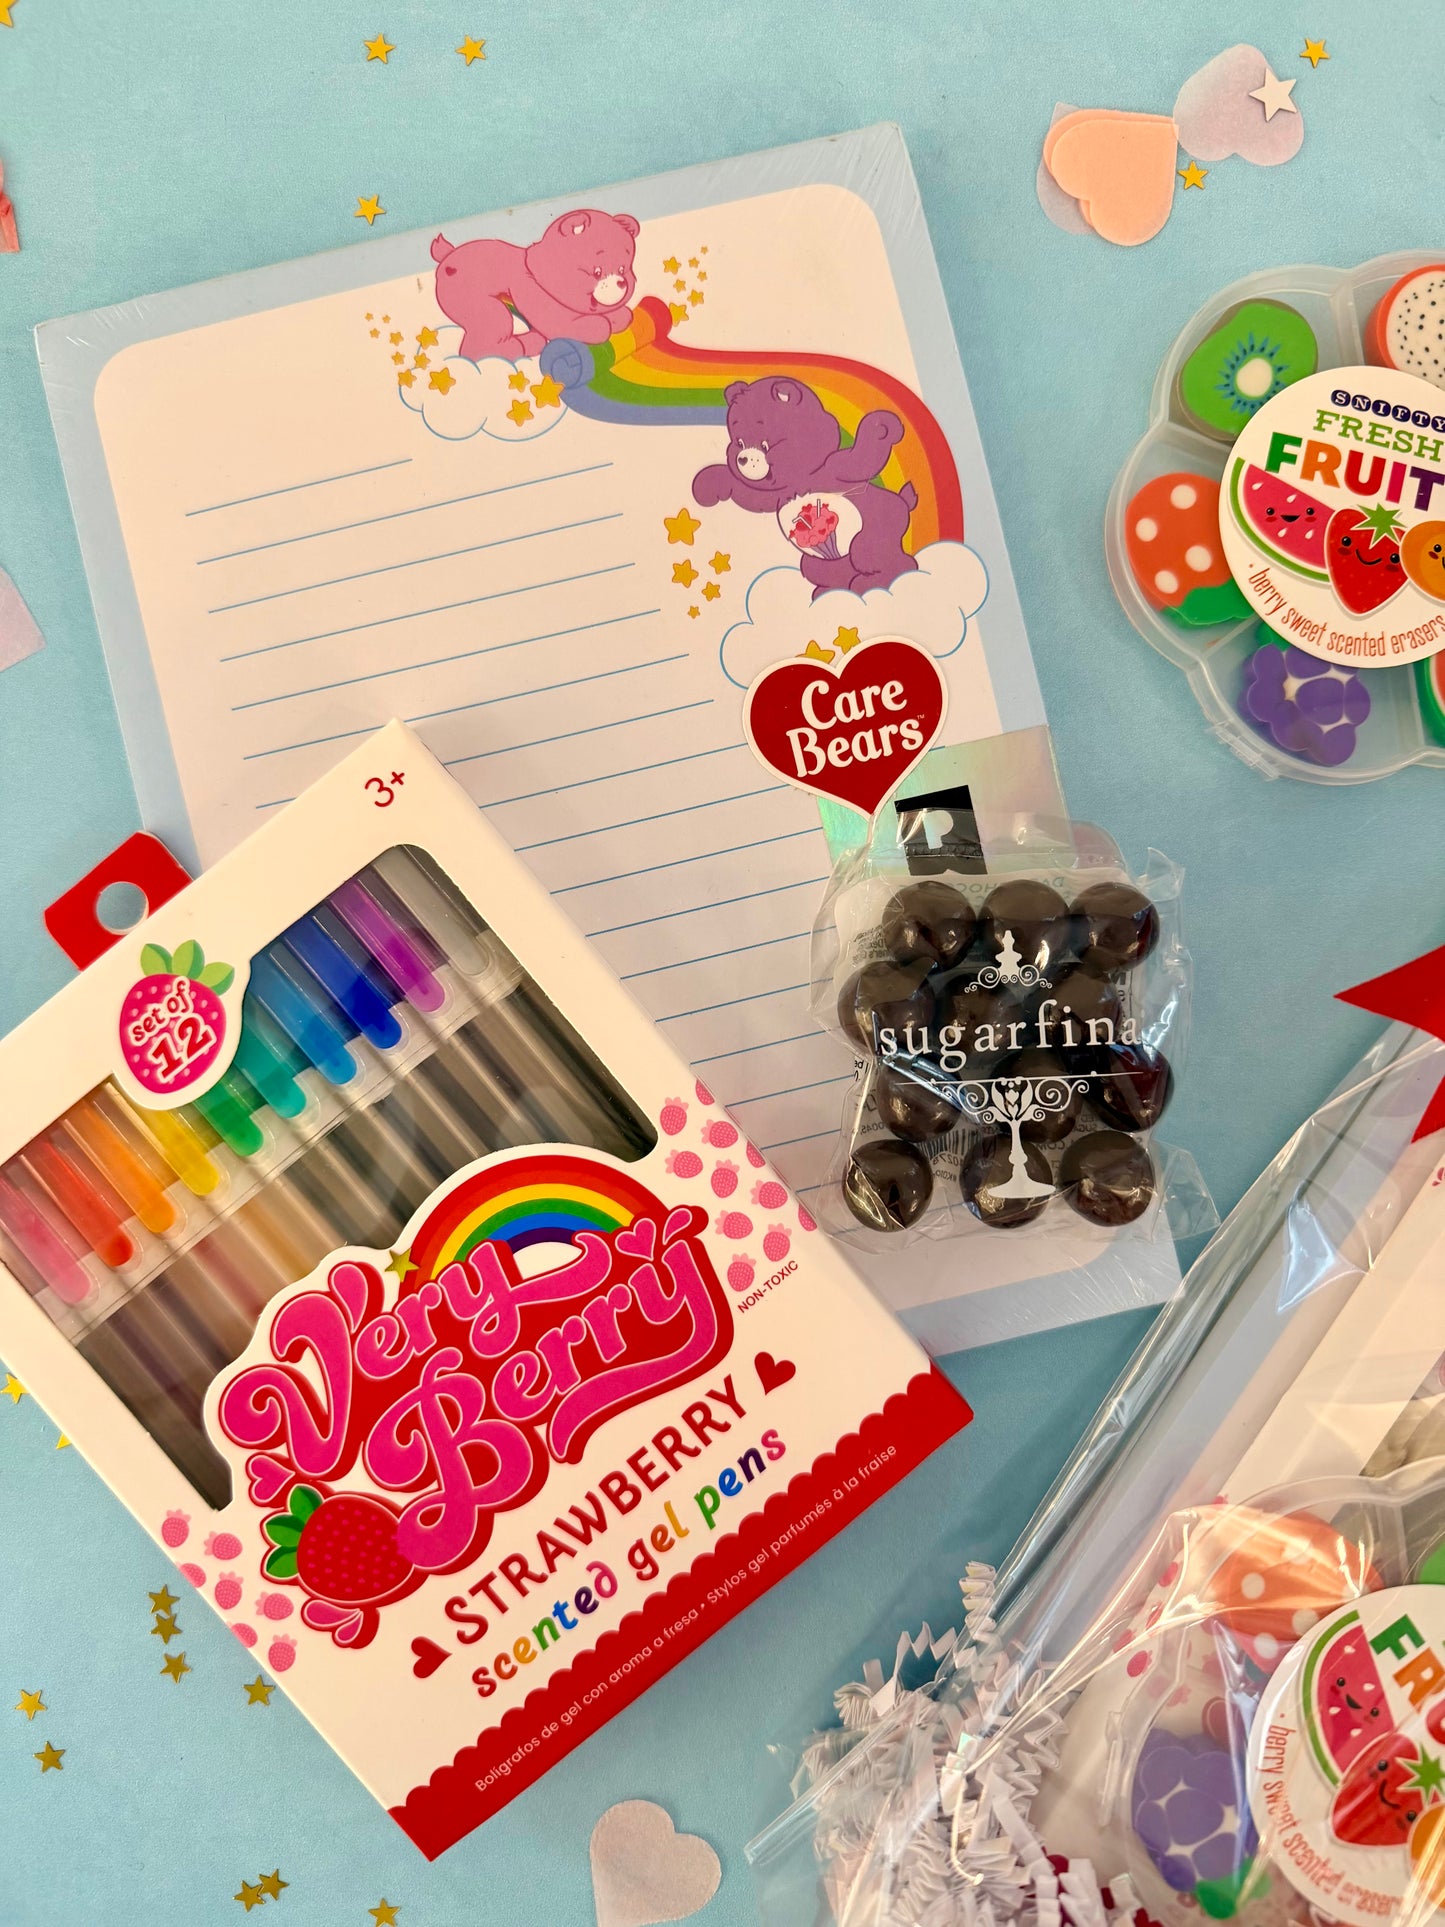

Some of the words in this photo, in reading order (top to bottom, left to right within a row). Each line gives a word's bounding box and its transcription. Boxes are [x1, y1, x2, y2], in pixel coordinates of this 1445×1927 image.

[1313, 409, 1444, 462] FRESH
[1331, 389, 1445, 434] SNIFTY
[1264, 431, 1445, 512] FRUIT
[1248, 567, 1287, 617] berry
[1281, 607, 1328, 647] sweet
[1326, 630, 1387, 658] scented
[1390, 614, 1445, 654] erasers
[800, 678, 908, 732] Care
[365, 771, 405, 807] 3+
[132, 1006, 166, 1042] set
[167, 980, 190, 1014] of
[878, 998, 1139, 1072] sugarfina
[151, 1016, 213, 1079] 12
[737, 1259, 799, 1314] NON-TOXIC
[220, 1232, 612, 1476] Very
[365, 1222, 718, 1569] Berry
[445, 1373, 747, 1645] STRAWBERRY
[471, 1560, 619, 1698] scented
[627, 1500, 690, 1582] gel
[693, 1429, 787, 1531] pens
[474, 1737, 541, 1792] Bolígrafos
[541, 1718, 560, 1739] de
[560, 1701, 583, 1726] gel
[582, 1681, 609, 1705] con
[608, 1646, 653, 1684] aroma
[653, 1636, 665, 1648] a
[663, 1608, 699, 1638] fresa
[706, 1568, 748, 1604] Stylos
[748, 1548, 771, 1574] gel
[769, 1498, 833, 1556] parfumés
[832, 1488, 844, 1502] à
[843, 1476, 859, 1492] la
[858, 1445, 897, 1480] fraise
[1256, 1724, 1296, 1775] berry
